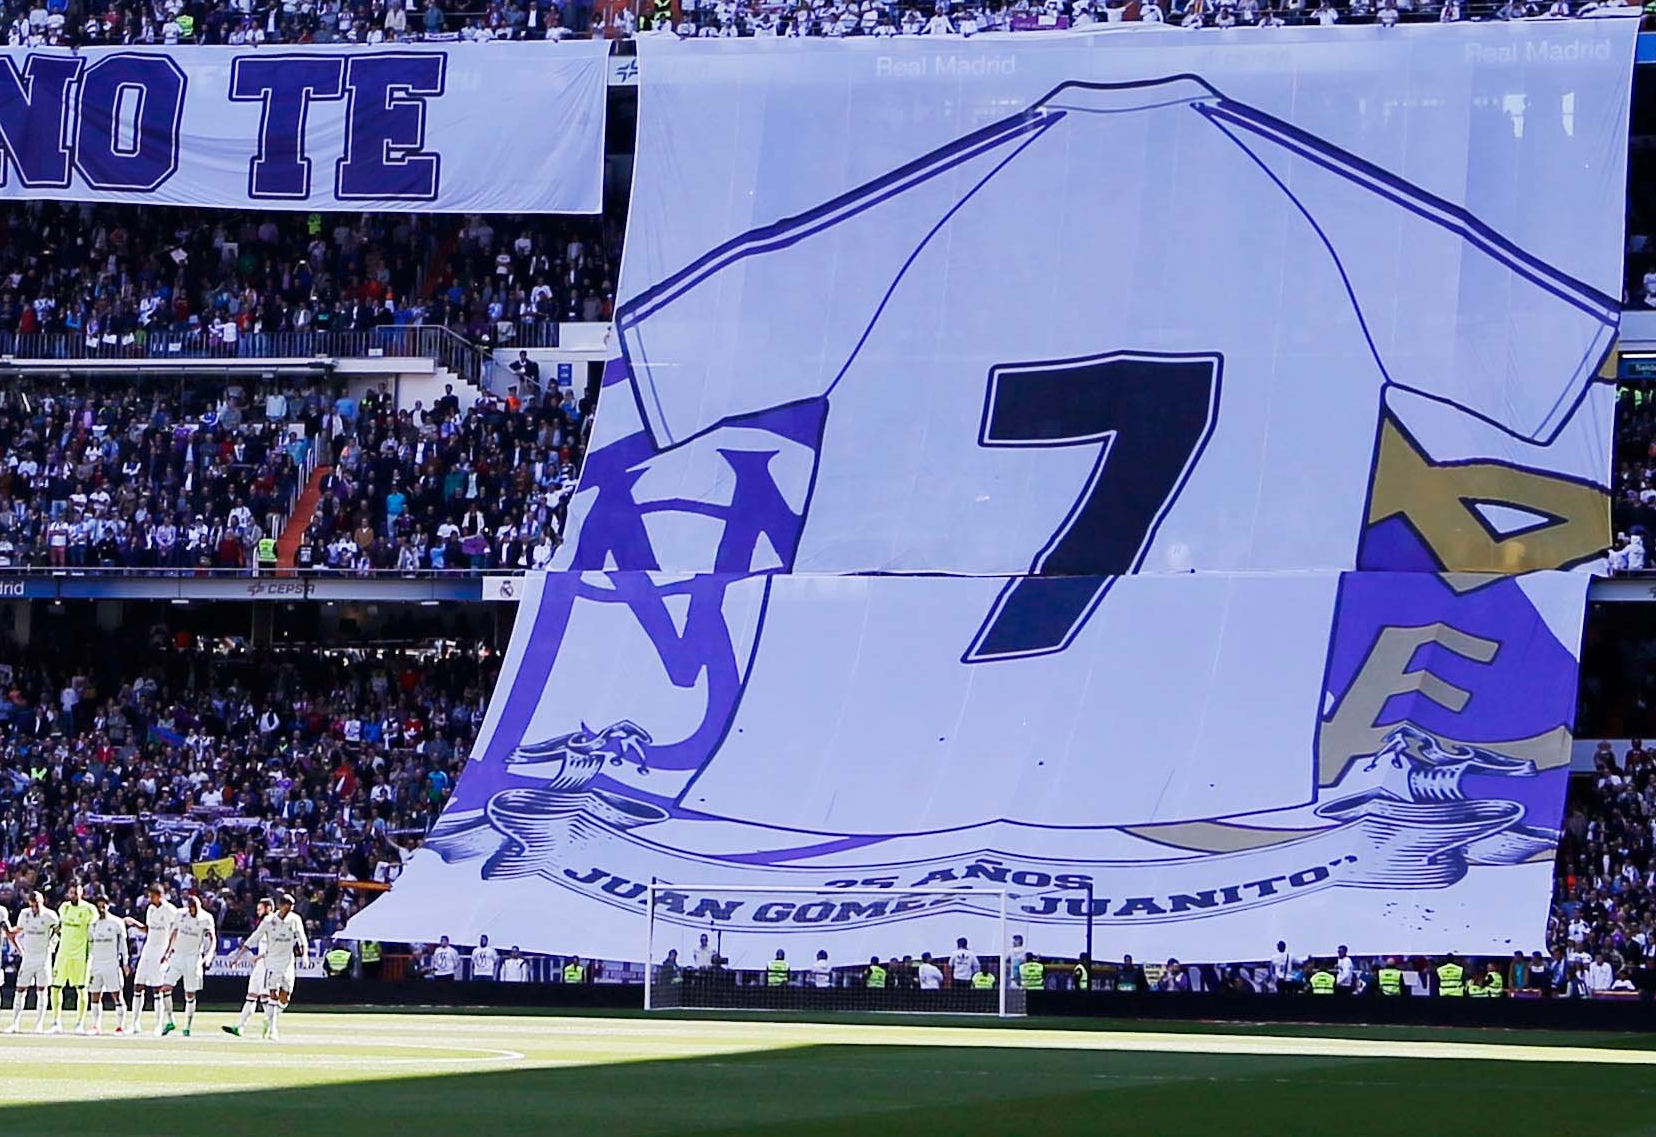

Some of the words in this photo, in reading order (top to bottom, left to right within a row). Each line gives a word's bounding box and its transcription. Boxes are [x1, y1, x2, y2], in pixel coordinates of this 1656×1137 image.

[229, 50, 447, 202] TE
[962, 349, 1224, 664] 7
[267, 584, 315, 595] CEPSA
[561, 865, 745, 921] JUAN
[911, 858, 1093, 890] AÑOS
